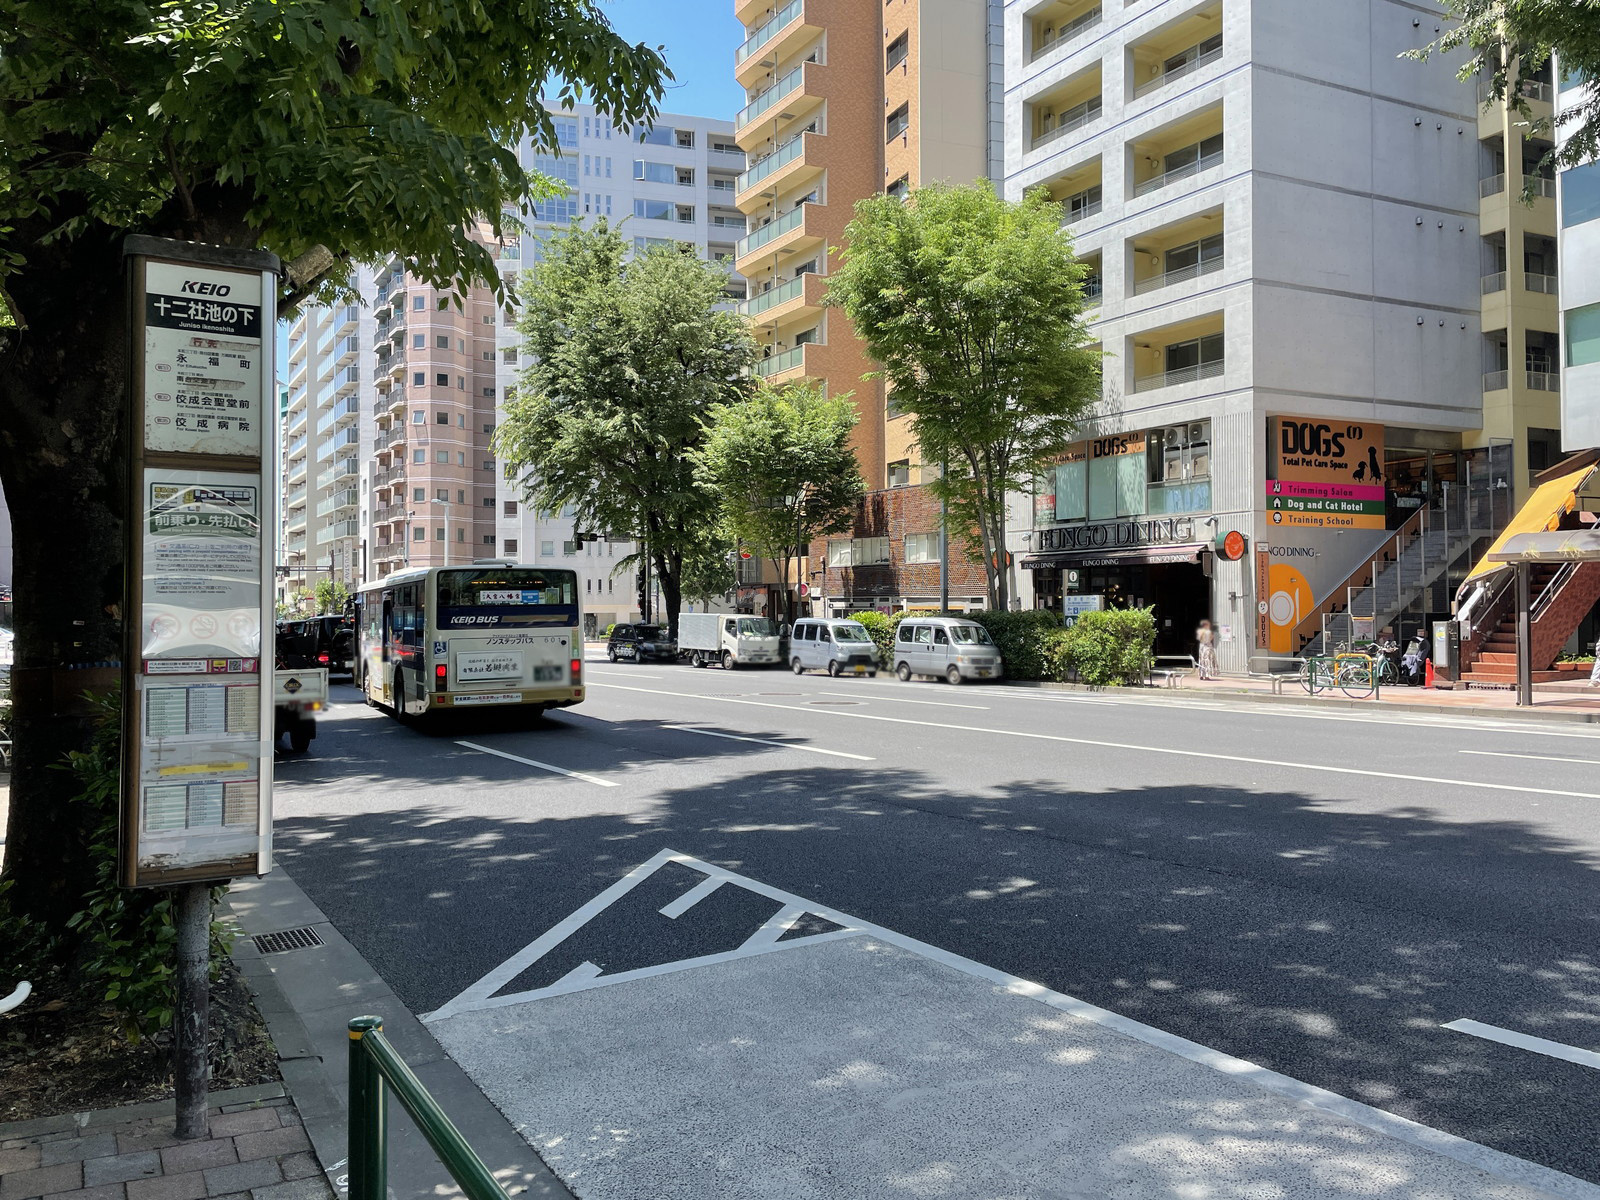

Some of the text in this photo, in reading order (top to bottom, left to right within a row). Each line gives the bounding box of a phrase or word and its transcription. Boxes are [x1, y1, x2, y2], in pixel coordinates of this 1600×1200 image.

[181, 280, 231, 297] KEIO
[153, 297, 255, 326] 十二社池の下
[178, 321, 201, 329] Juniso
[176, 353, 251, 370] 永福町
[176, 394, 250, 409] 佼成会聖堂前
[176, 417, 250, 432] 佼成病院
[1282, 456, 1348, 470] Total Pet Care Space
[1288, 485, 1353, 497] Trimming Salon
[1287, 499, 1363, 511] Dog and Cat Hotel
[1288, 514, 1354, 526] Training School
[1038, 524, 1108, 551] FUNGO
[1114, 516, 1193, 547] DINING
[1268, 546, 1286, 557] NGO
[1286, 546, 1315, 557] DINING
[1041, 561, 1056, 569] DINING
[450, 615, 500, 624] KEIO BUS
[486, 637, 535, 645] ノンステップバス
